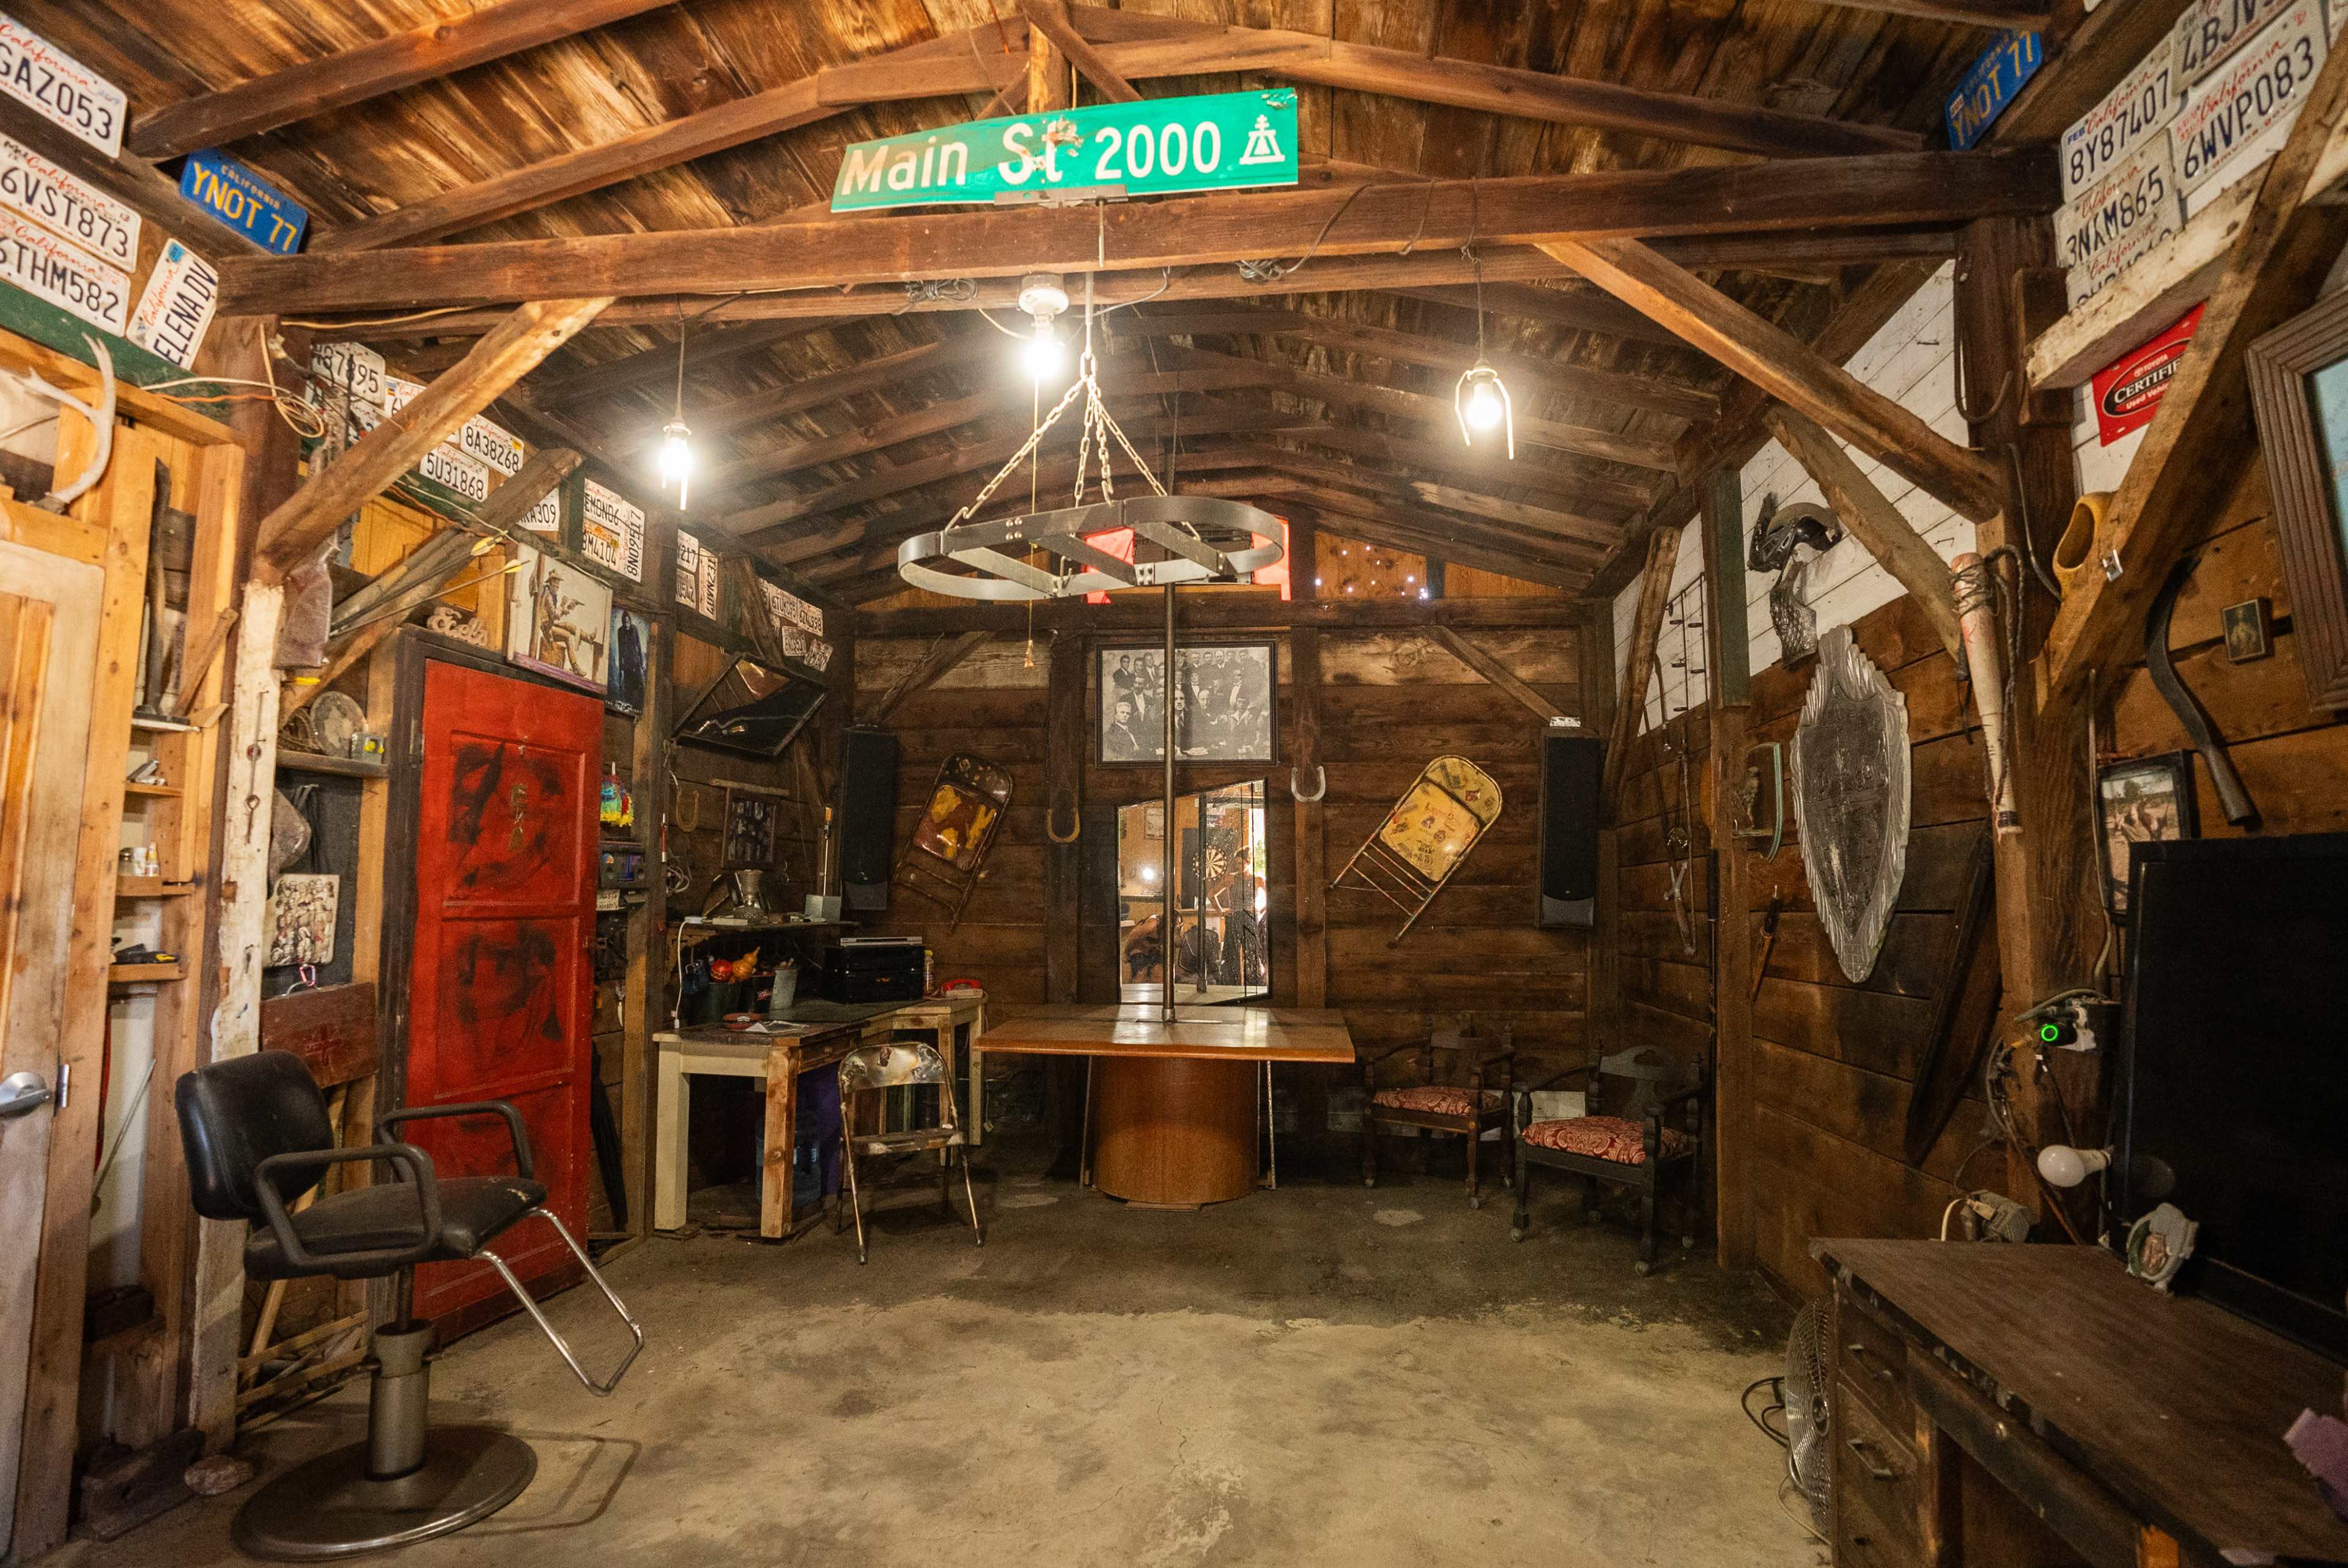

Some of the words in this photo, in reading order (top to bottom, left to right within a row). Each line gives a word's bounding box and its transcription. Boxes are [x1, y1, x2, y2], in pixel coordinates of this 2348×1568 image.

[2007, 31, 2033, 76] 77
[2182, 0, 2270, 74] 4BJV
[2070, 68, 2169, 185] 8Y87407
[2184, 35, 2313, 179] 6WVP083
[841, 136, 969, 196] Main
[998, 123, 1063, 185] St
[1095, 122, 1222, 180] 2000
[2, 166, 128, 257] 6VST873
[193, 161, 264, 229] YNOT
[269, 213, 298, 252] 77
[153, 291, 205, 367] ELENA
[426, 452, 484, 500] 5U31868
[465, 425, 520, 473] 8A38268
